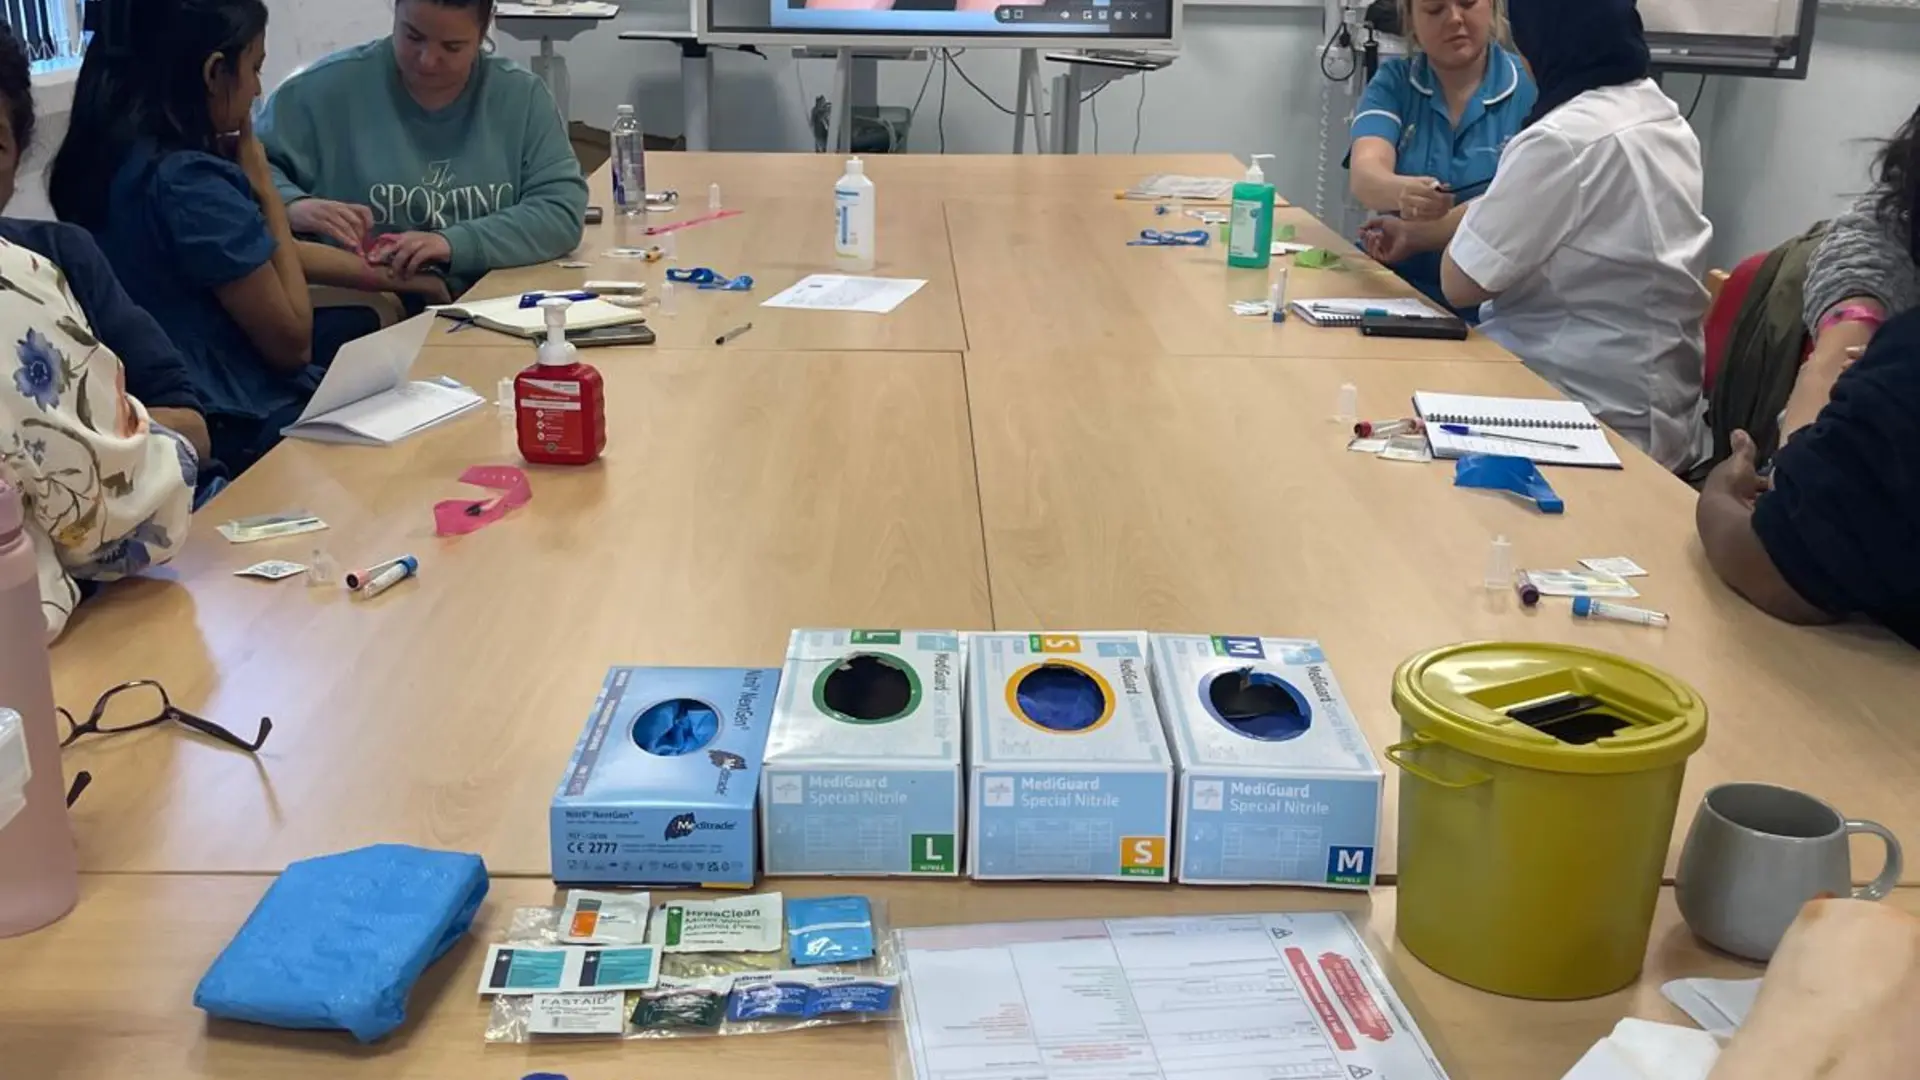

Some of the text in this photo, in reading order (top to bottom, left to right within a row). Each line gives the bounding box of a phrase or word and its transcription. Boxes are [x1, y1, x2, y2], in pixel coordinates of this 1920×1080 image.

[1227, 640, 1260, 654] M
[809, 775, 888, 789] MediGuard
[1021, 776, 1100, 790] MediGuard
[1230, 782, 1310, 798] MediGuard
[809, 791, 908, 806] Special Nitrile
[1021, 793, 1120, 809] Special Nitrile
[1229, 798, 1330, 815] Special Nitrile
[588, 842, 618, 855] 2777
[926, 837, 942, 860] L
[1134, 840, 1152, 864] S
[1337, 850, 1364, 873] M
